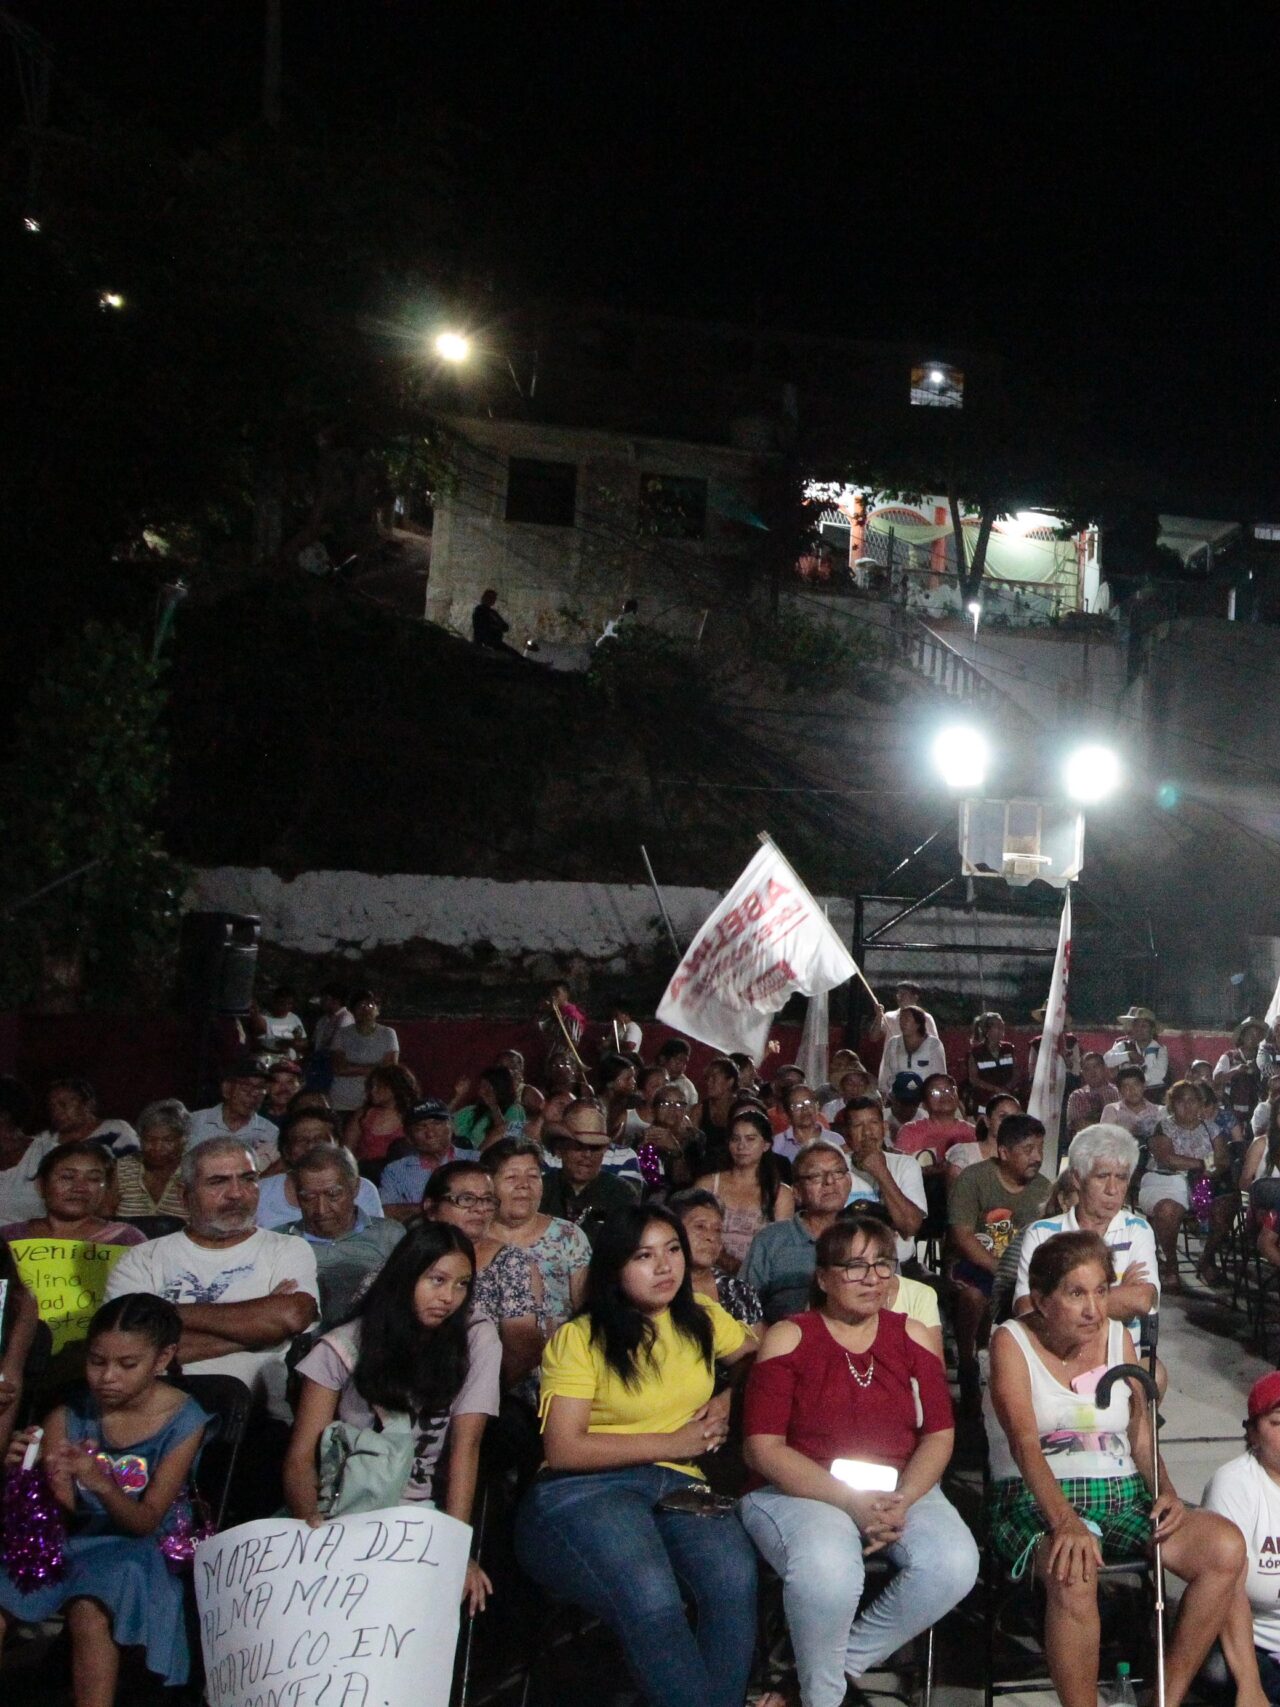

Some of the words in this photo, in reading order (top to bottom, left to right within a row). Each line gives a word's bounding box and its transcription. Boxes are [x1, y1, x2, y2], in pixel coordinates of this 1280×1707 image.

[203, 1522, 345, 1599] MORENA
[354, 1520, 439, 1567] DEL
[203, 1581, 274, 1655] ALMA
[209, 1629, 330, 1707] ACAPULCO
[340, 1624, 416, 1660] EN
